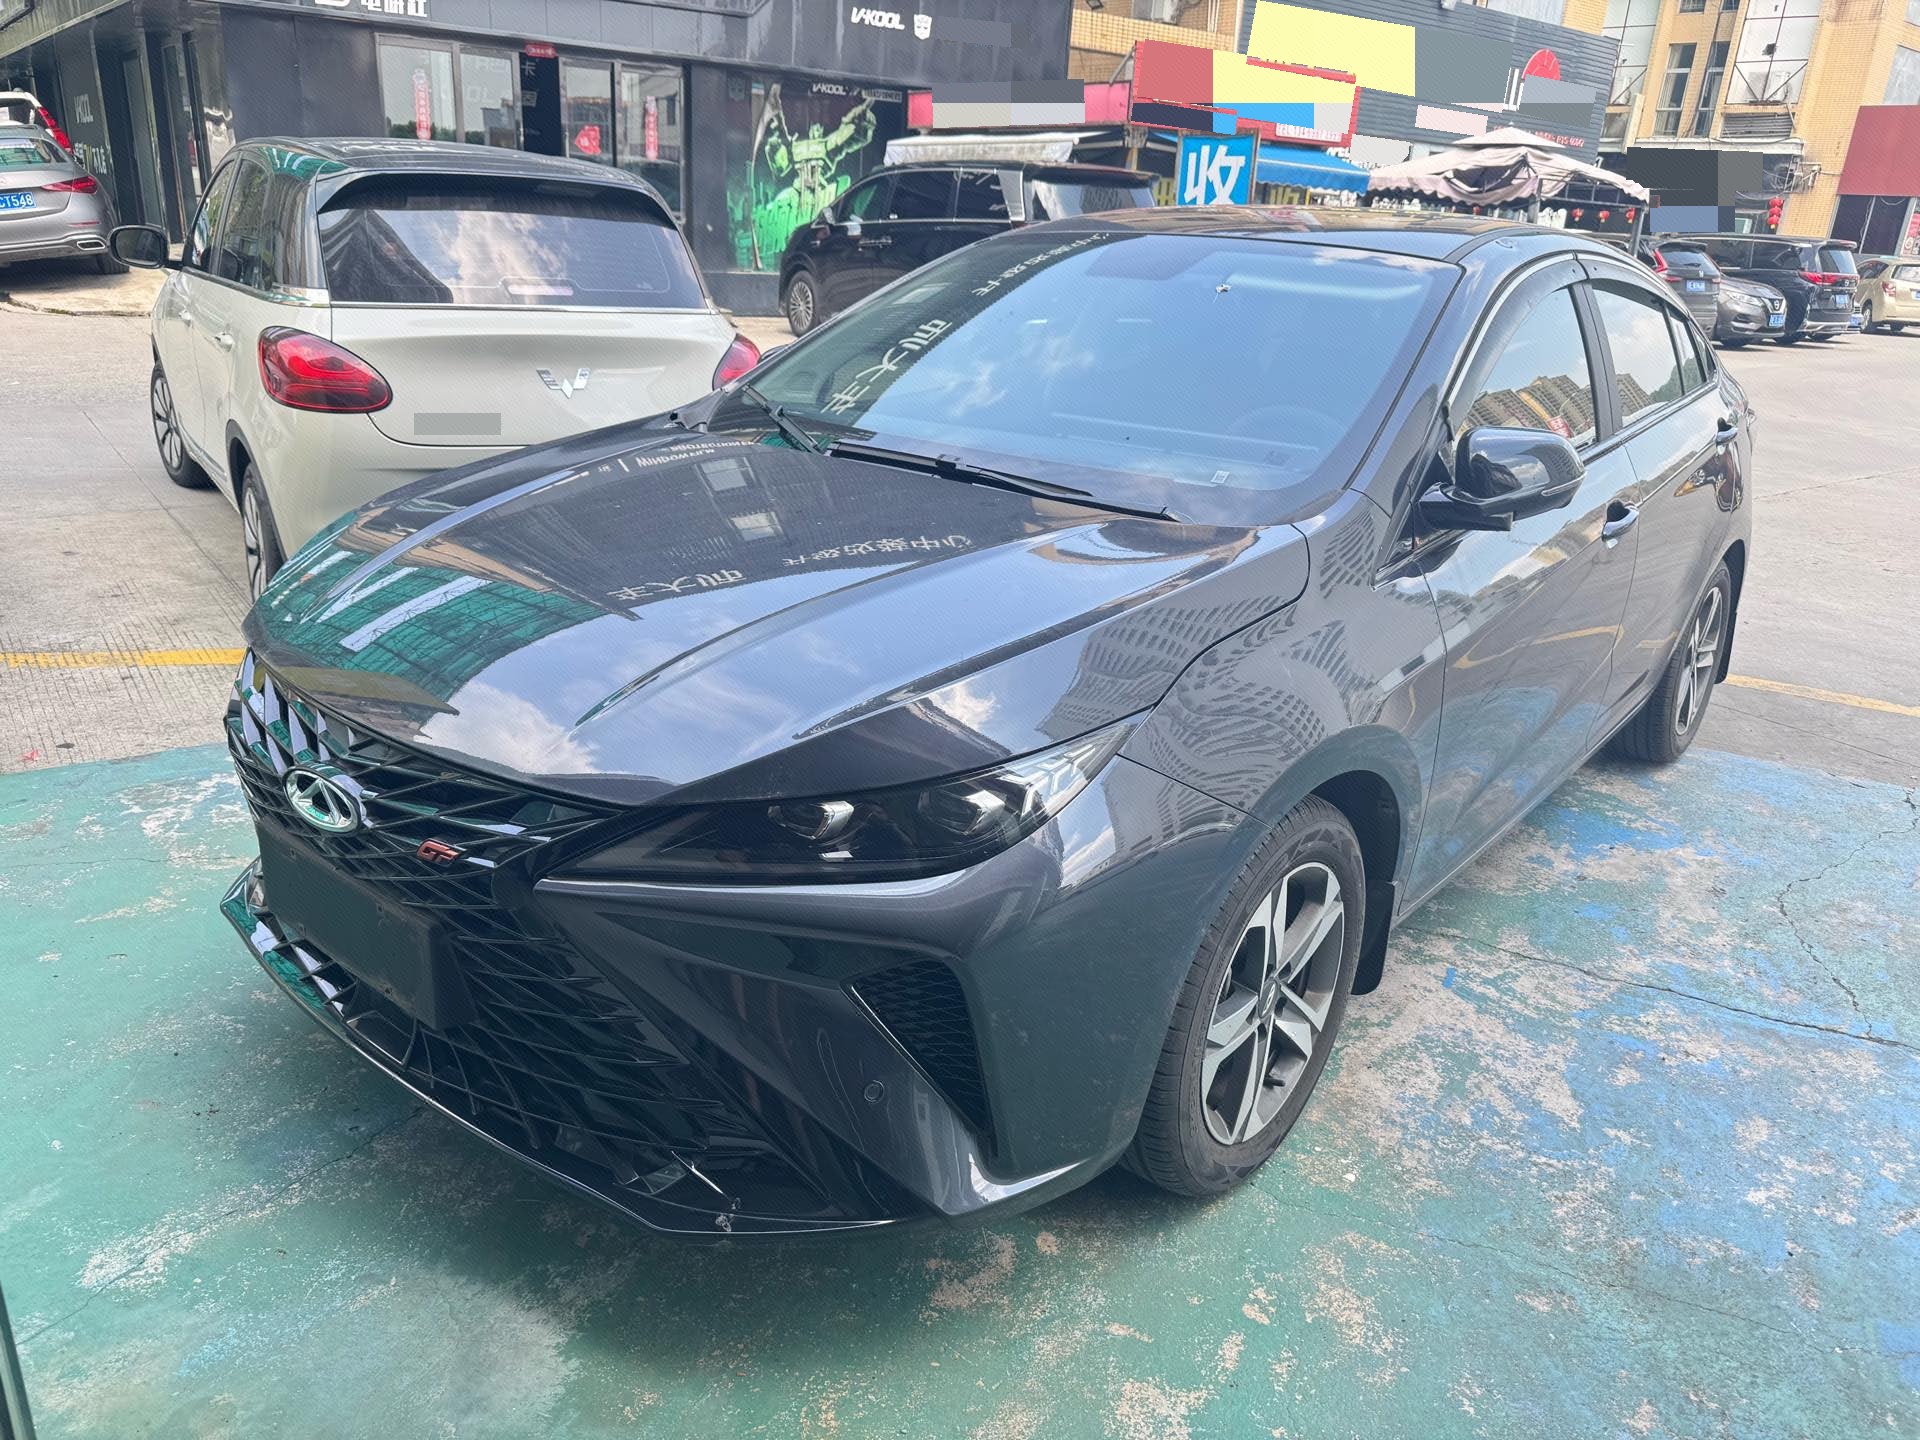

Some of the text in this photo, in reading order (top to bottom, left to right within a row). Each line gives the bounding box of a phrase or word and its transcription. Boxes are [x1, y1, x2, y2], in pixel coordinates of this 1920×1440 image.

[850, 7, 905, 30] V-KOOL
[812, 82, 847, 96] V-KOOL
[1184, 144, 1246, 205] 收
